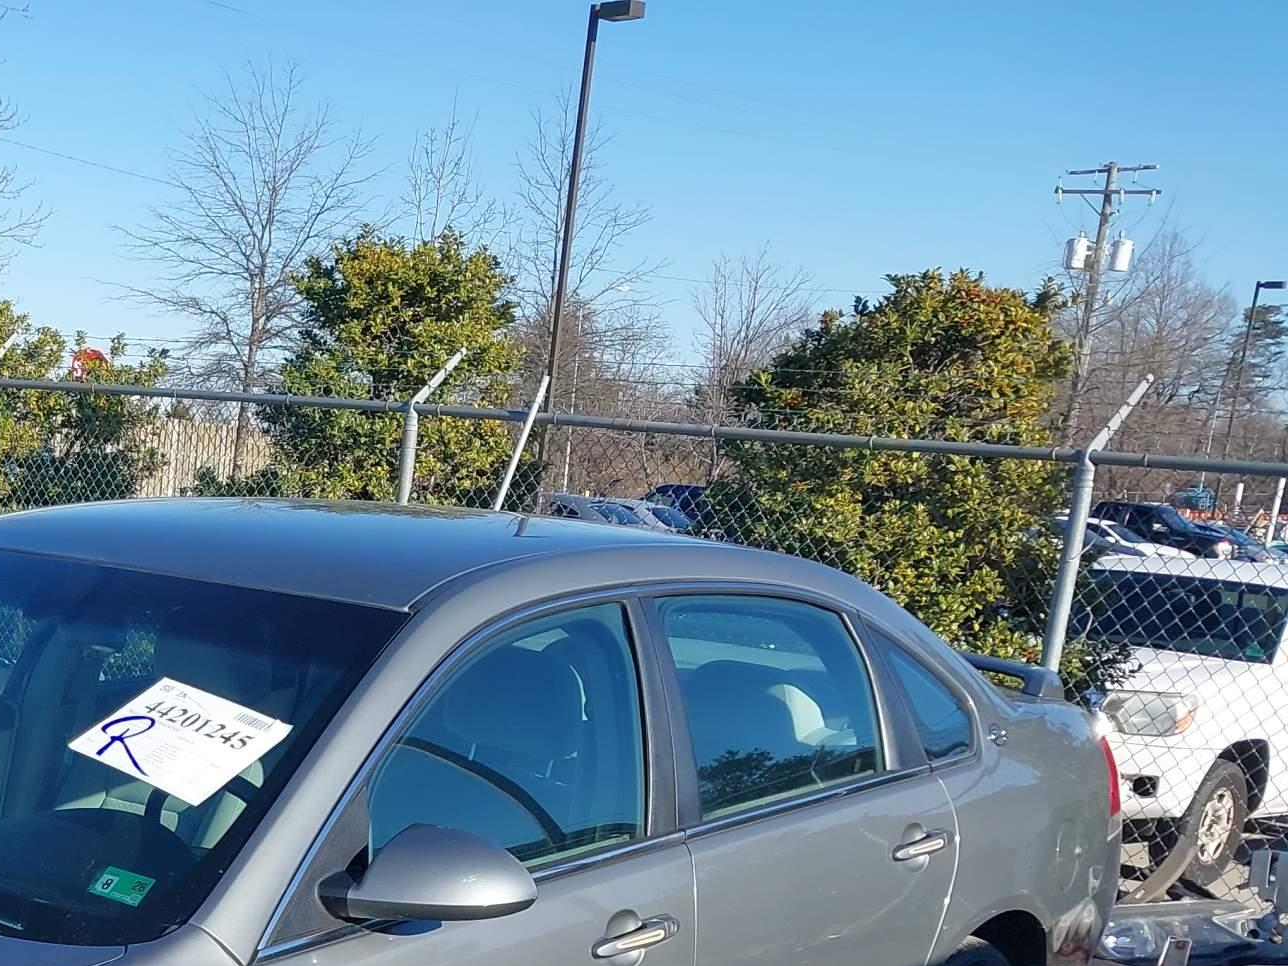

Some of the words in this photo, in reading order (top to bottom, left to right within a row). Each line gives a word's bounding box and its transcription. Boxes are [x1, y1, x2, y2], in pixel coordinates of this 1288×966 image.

[96, 715, 156, 777] R
[145, 701, 255, 750] 44201245
[101, 878, 114, 890] 8
[130, 880, 148, 893] 26
